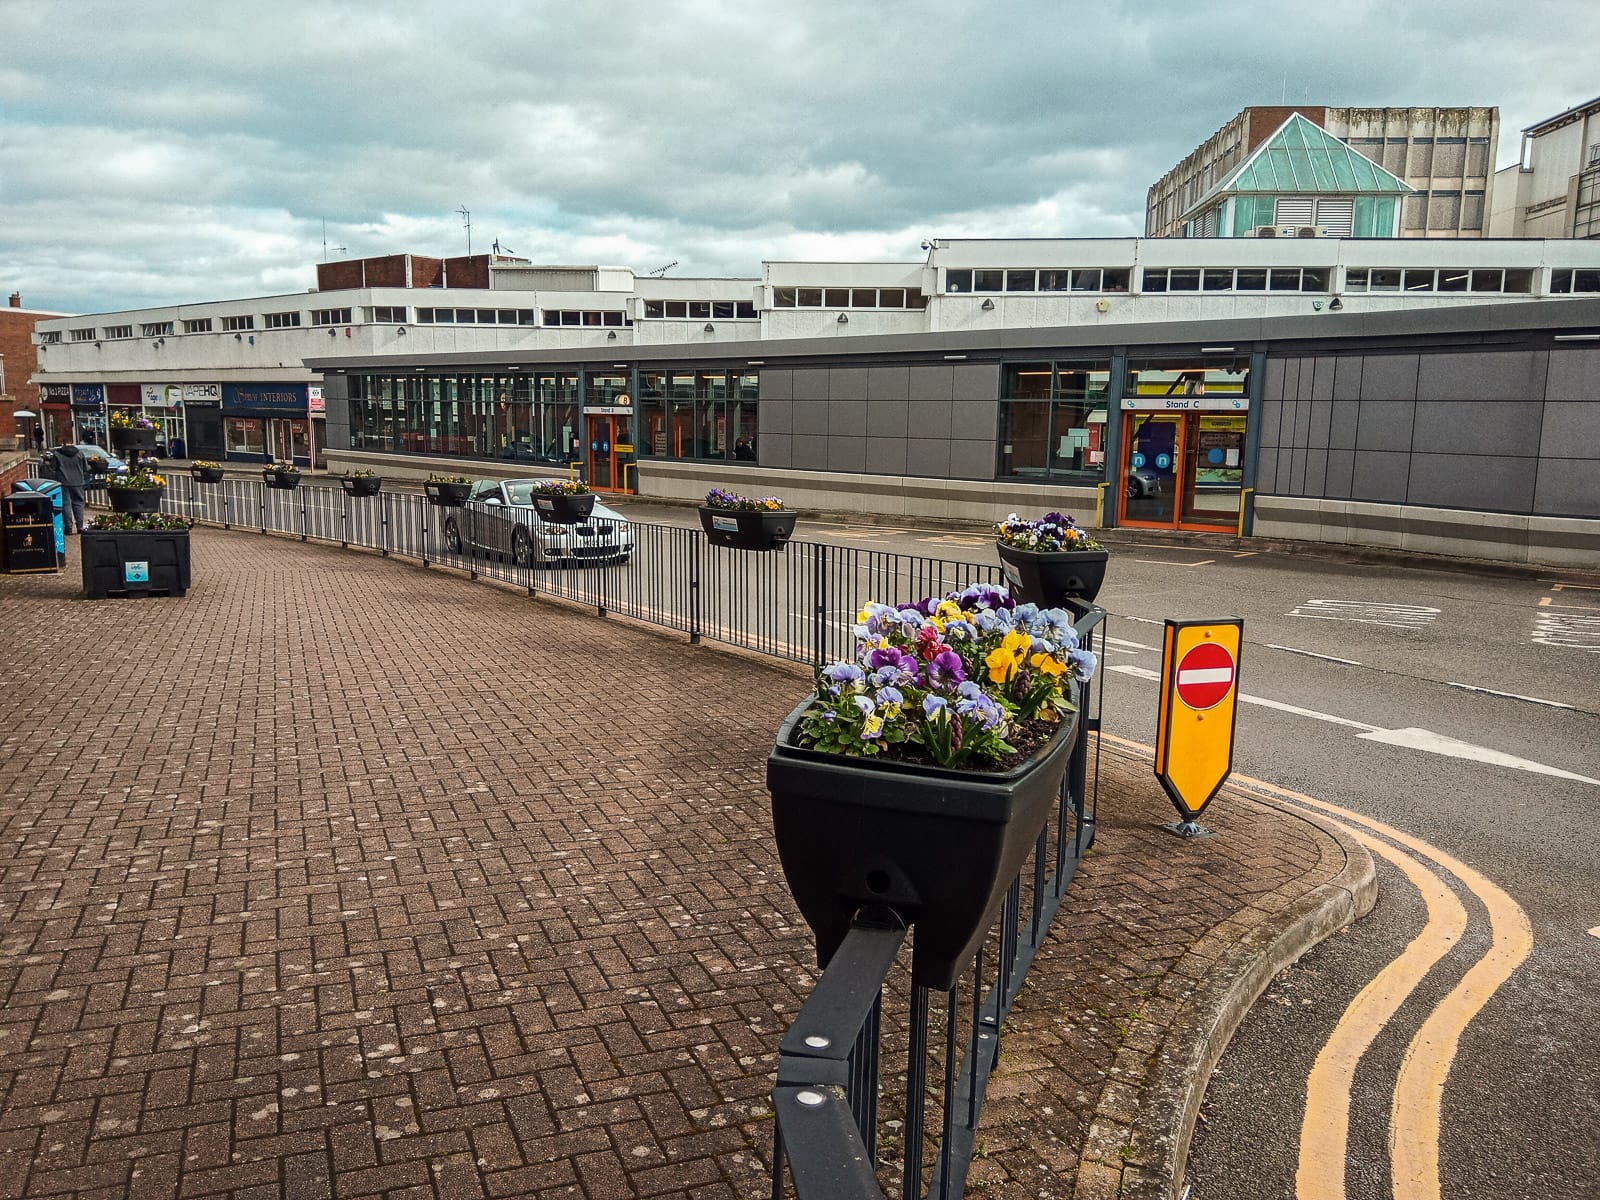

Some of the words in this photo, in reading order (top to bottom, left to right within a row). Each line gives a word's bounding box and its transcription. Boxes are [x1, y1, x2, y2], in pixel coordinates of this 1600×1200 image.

[260, 392, 297, 403] INTERIORS
[1165, 400, 1189, 409] Stand
[1193, 400, 1200, 409] C
